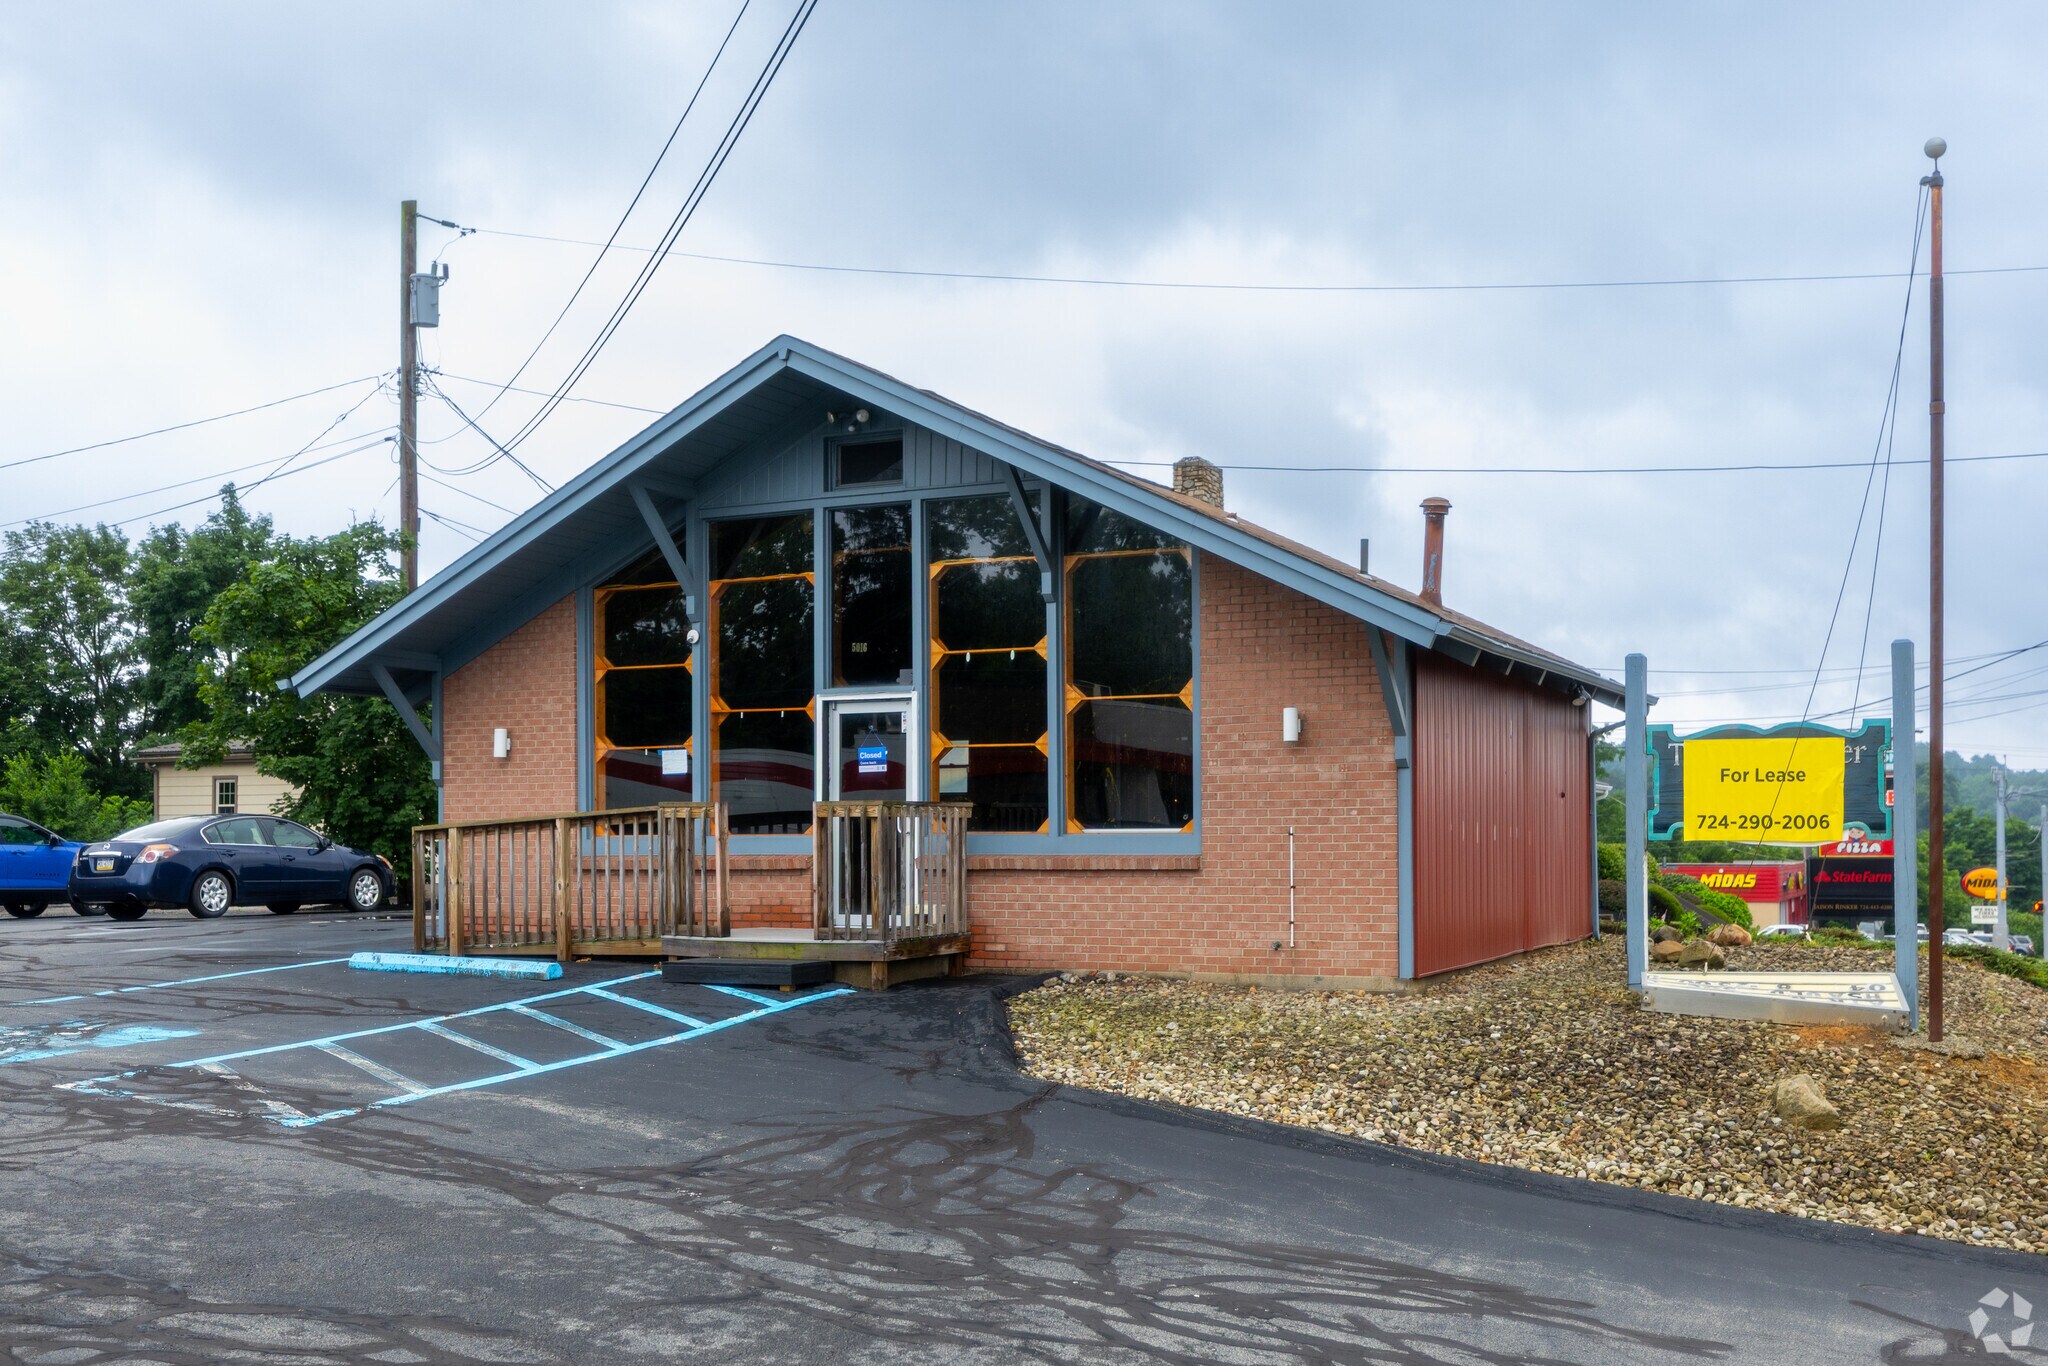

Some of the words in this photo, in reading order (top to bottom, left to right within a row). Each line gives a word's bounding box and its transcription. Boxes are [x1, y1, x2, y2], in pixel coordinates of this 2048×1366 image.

[851, 642, 868, 653] 5016
[859, 751, 882, 759] Closed
[1720, 768, 1750, 783] For
[1755, 768, 1807, 783] Lease
[1697, 814, 1830, 830] 724-290-2006
[1836, 842, 1882, 854] PIZZA
[1700, 868, 1757, 888] MIDAS
[1965, 875, 1998, 888] MIDA
